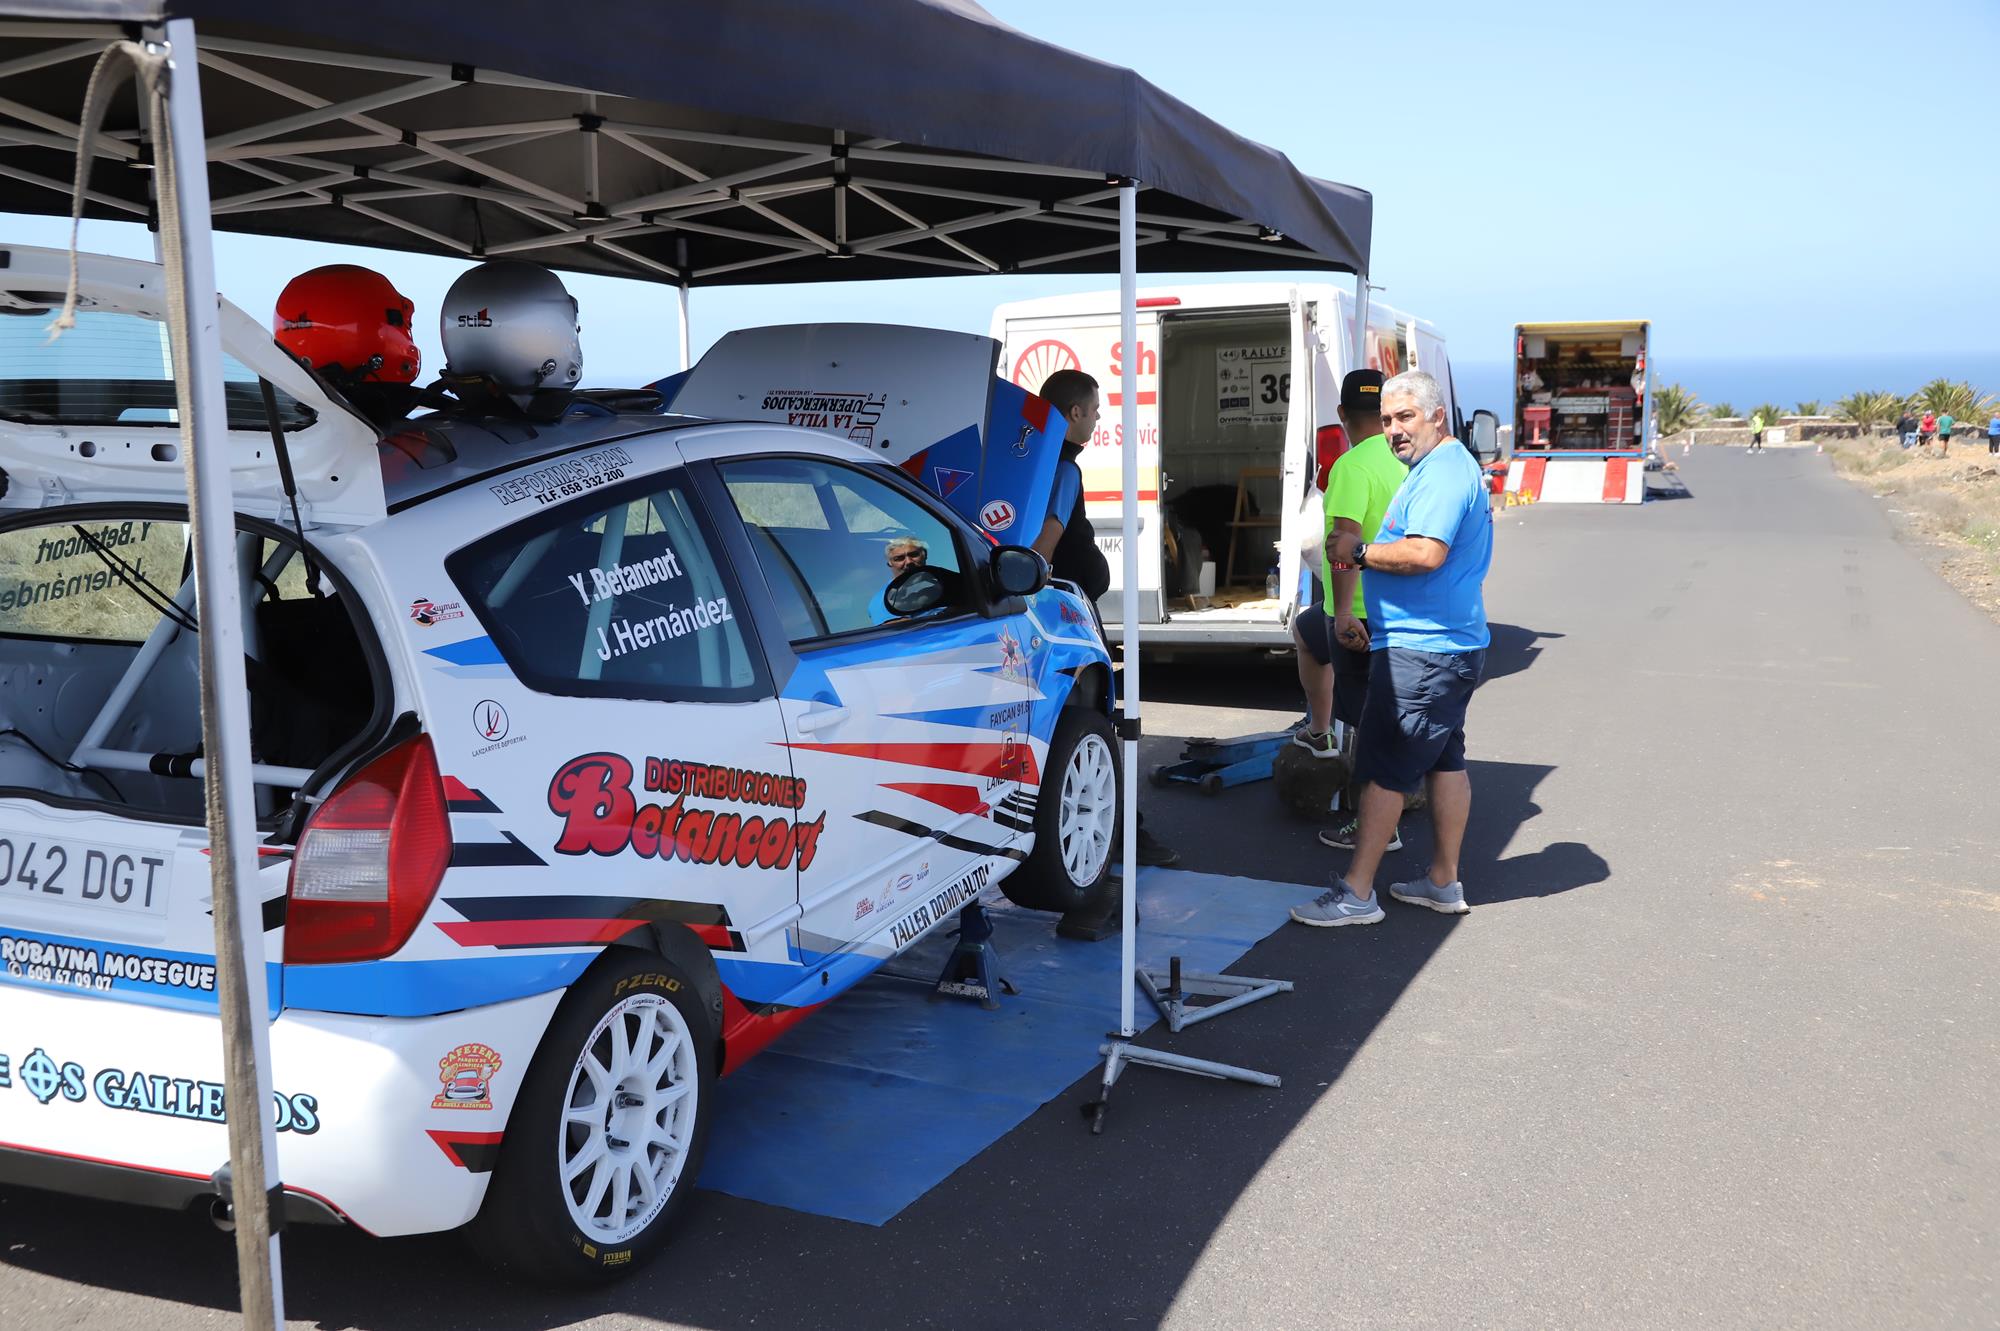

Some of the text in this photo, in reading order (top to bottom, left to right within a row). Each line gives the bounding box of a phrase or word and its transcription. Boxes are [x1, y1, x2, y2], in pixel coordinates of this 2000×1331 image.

[1241, 347, 1286, 358] RALLYE
[761, 396, 885, 425] SUPERMERCADOS
[788, 412, 853, 428] LA VILLA
[1094, 424, 1110, 447] de
[489, 446, 633, 506] REFORMAS FRAN
[562, 481, 583, 496] 658
[585, 474, 604, 489] 332
[604, 468, 625, 482] 200
[597, 597, 733, 661] J.Hernández
[644, 756, 806, 810] DISTRIBUCIONES
[548, 751, 826, 873] Betancort
[82, 849, 164, 907] DGT
[890, 905, 932, 949] TALLER
[0, 936, 217, 991] ROBAYNA MOSEGUE
[28, 964, 113, 991] 609 67 09 07
[94, 1068, 320, 1135] GALLEOS
